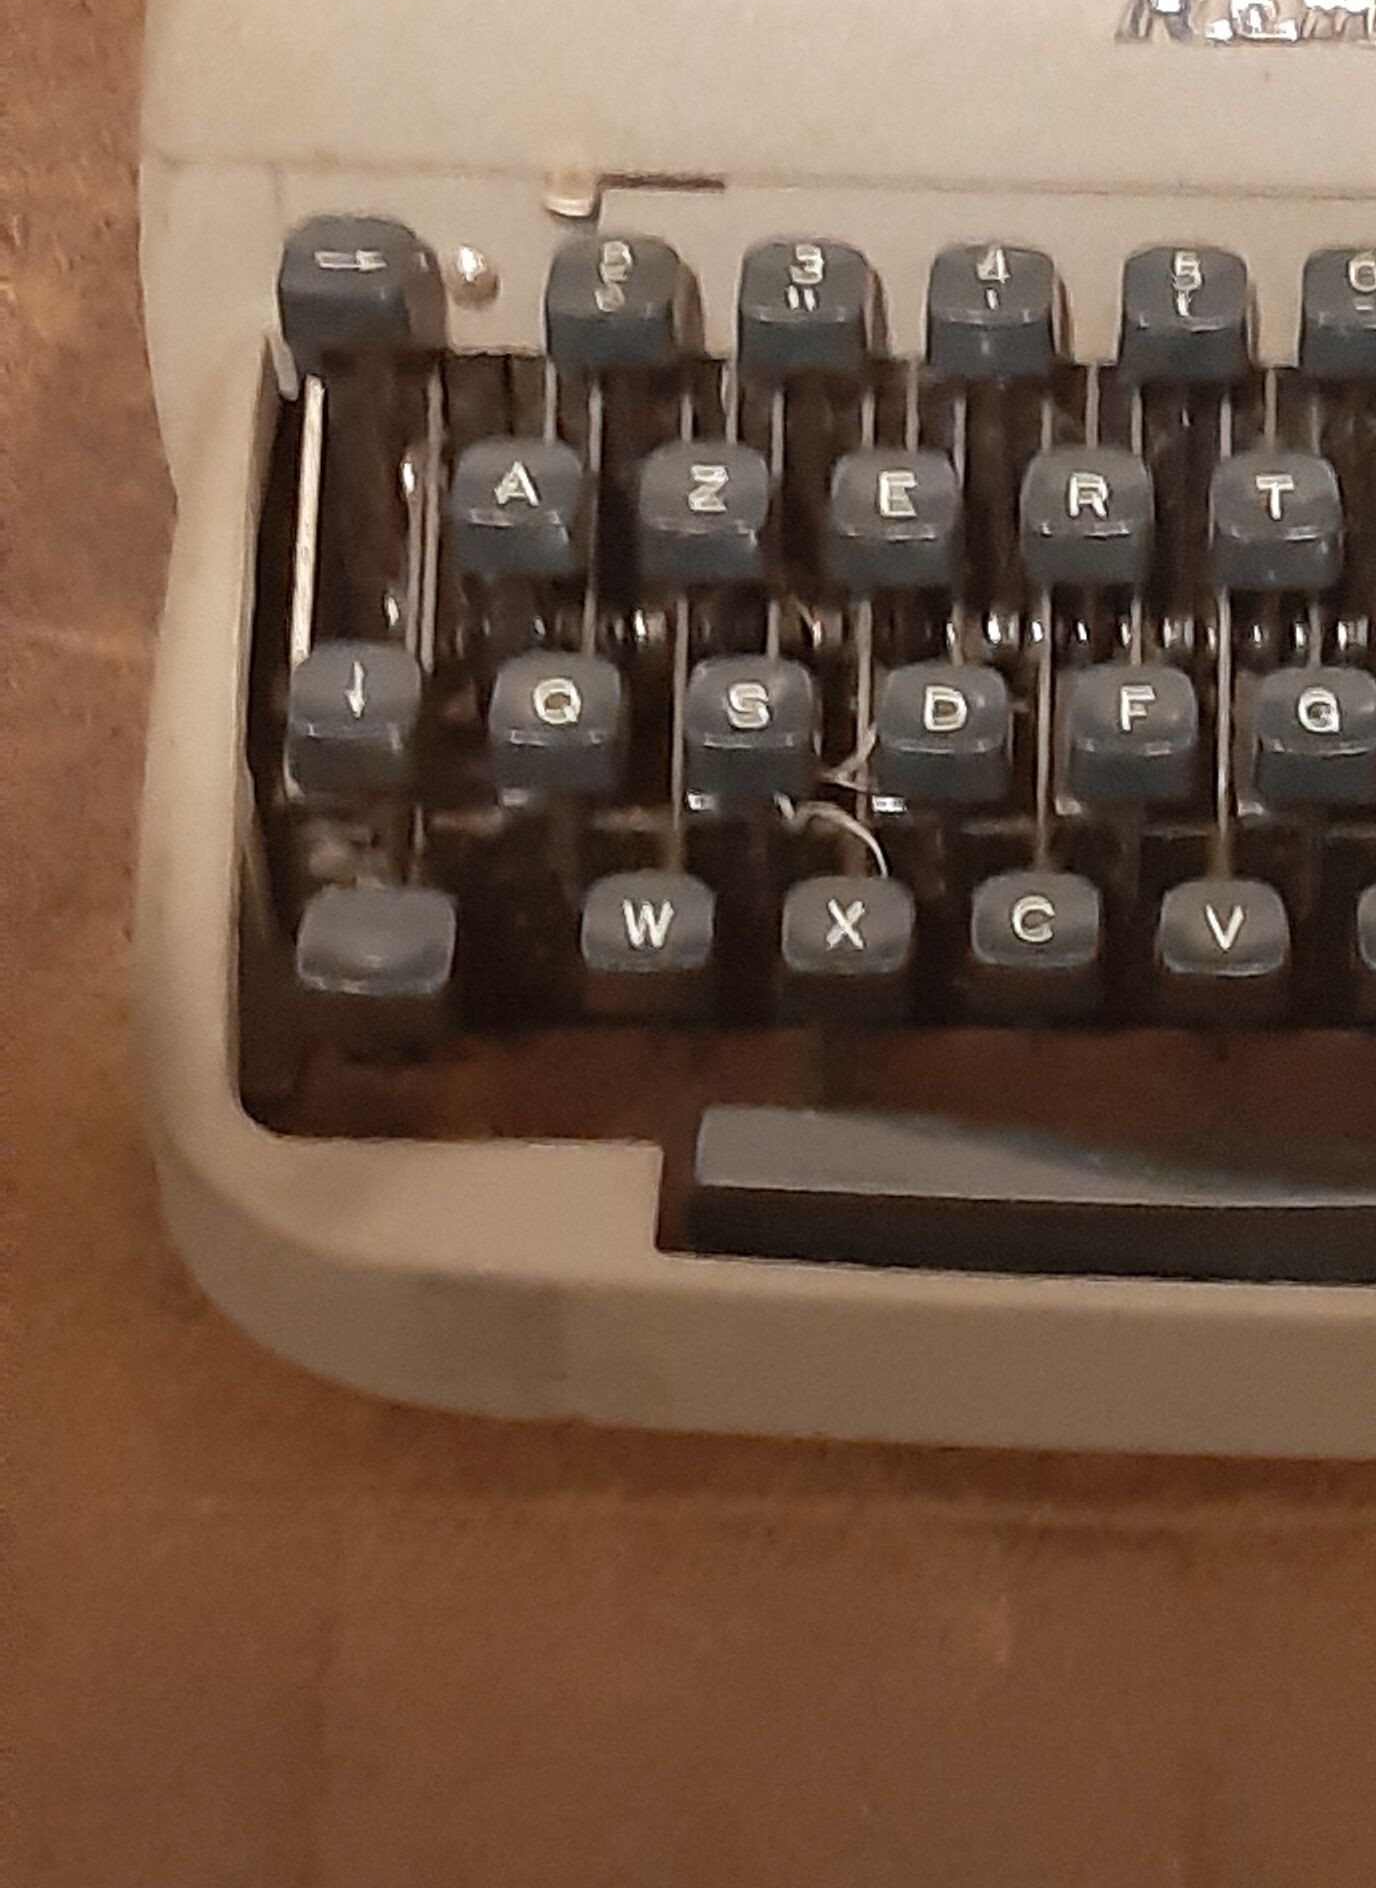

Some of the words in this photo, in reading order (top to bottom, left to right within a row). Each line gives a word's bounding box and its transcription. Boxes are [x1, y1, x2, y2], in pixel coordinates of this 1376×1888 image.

[790, 243, 825, 284] 3
[977, 245, 1010, 284] 4
[1174, 251, 1202, 291] 5
[494, 461, 539, 506] A
[688, 464, 729, 512] Z
[879, 471, 918, 517] E
[1069, 472, 1108, 517] R
[1255, 474, 1295, 519] T
[533, 678, 581, 724] Q
[725, 683, 770, 728] S
[923, 686, 968, 731] D
[1120, 685, 1156, 731] F
[1298, 687, 1340, 732] G
[622, 899, 674, 948] W
[826, 899, 865, 949] X
[1012, 896, 1056, 942] C
[1206, 905, 1244, 950] V
